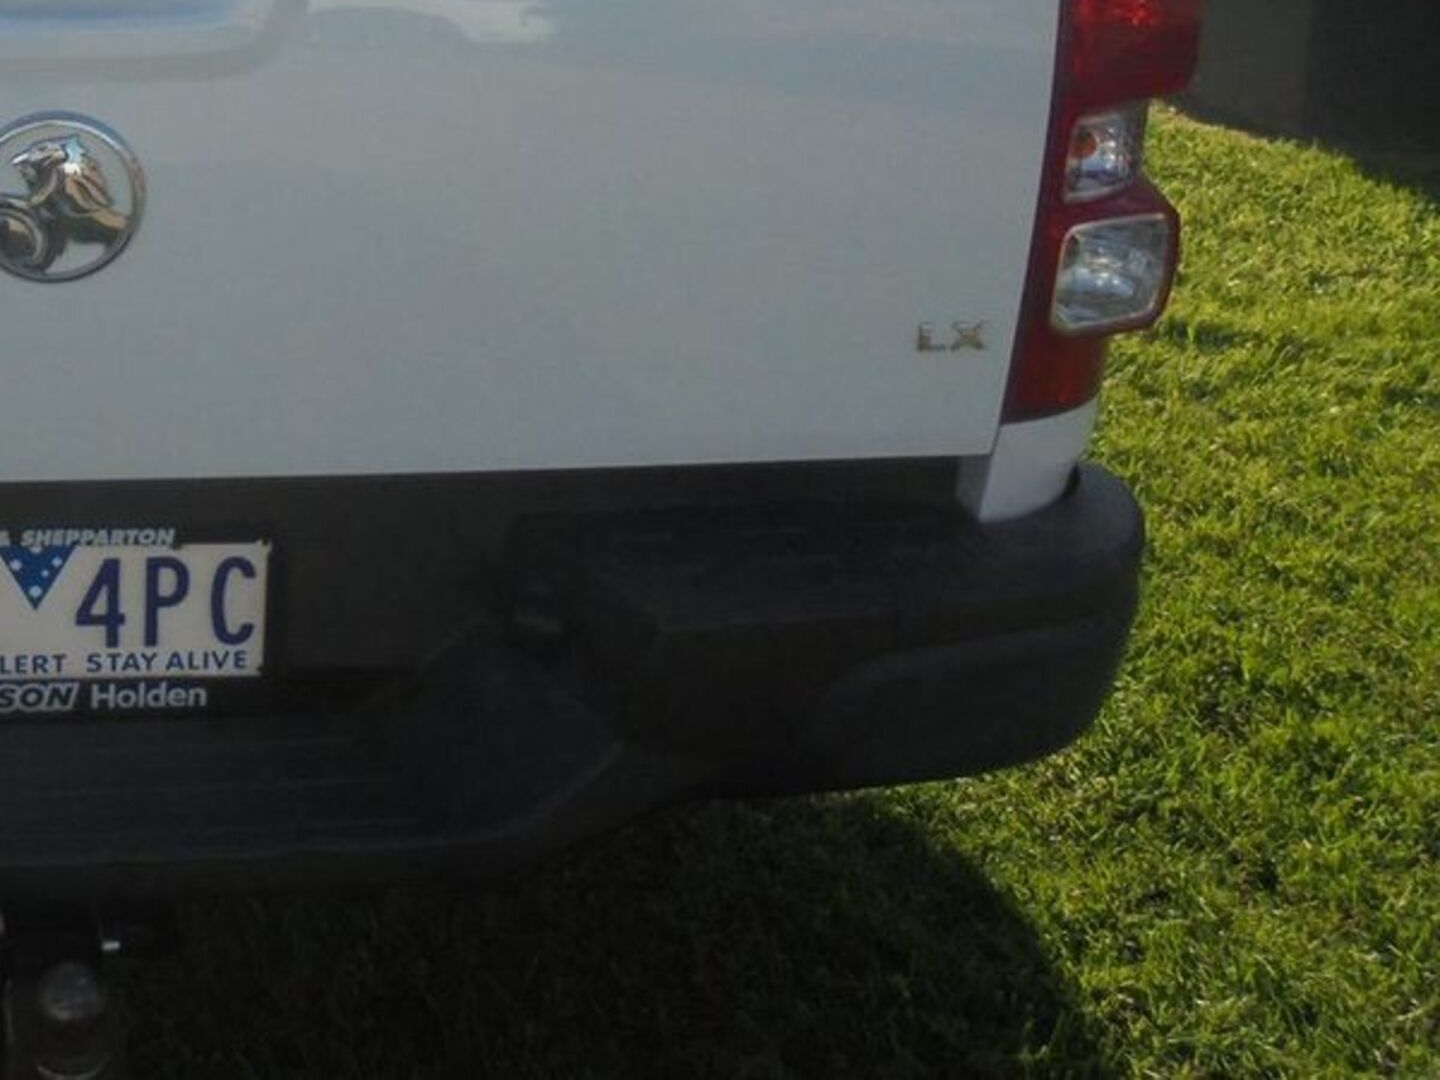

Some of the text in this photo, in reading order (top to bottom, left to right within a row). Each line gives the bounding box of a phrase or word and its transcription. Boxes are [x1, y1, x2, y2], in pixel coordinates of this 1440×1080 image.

[914, 321, 988, 354] LX
[21, 528, 176, 548] SHEPPARTON
[74, 556, 257, 648] 4PC
[86, 652, 159, 673] STAY
[166, 650, 248, 671] ALIVE
[90, 683, 207, 710] Holden
